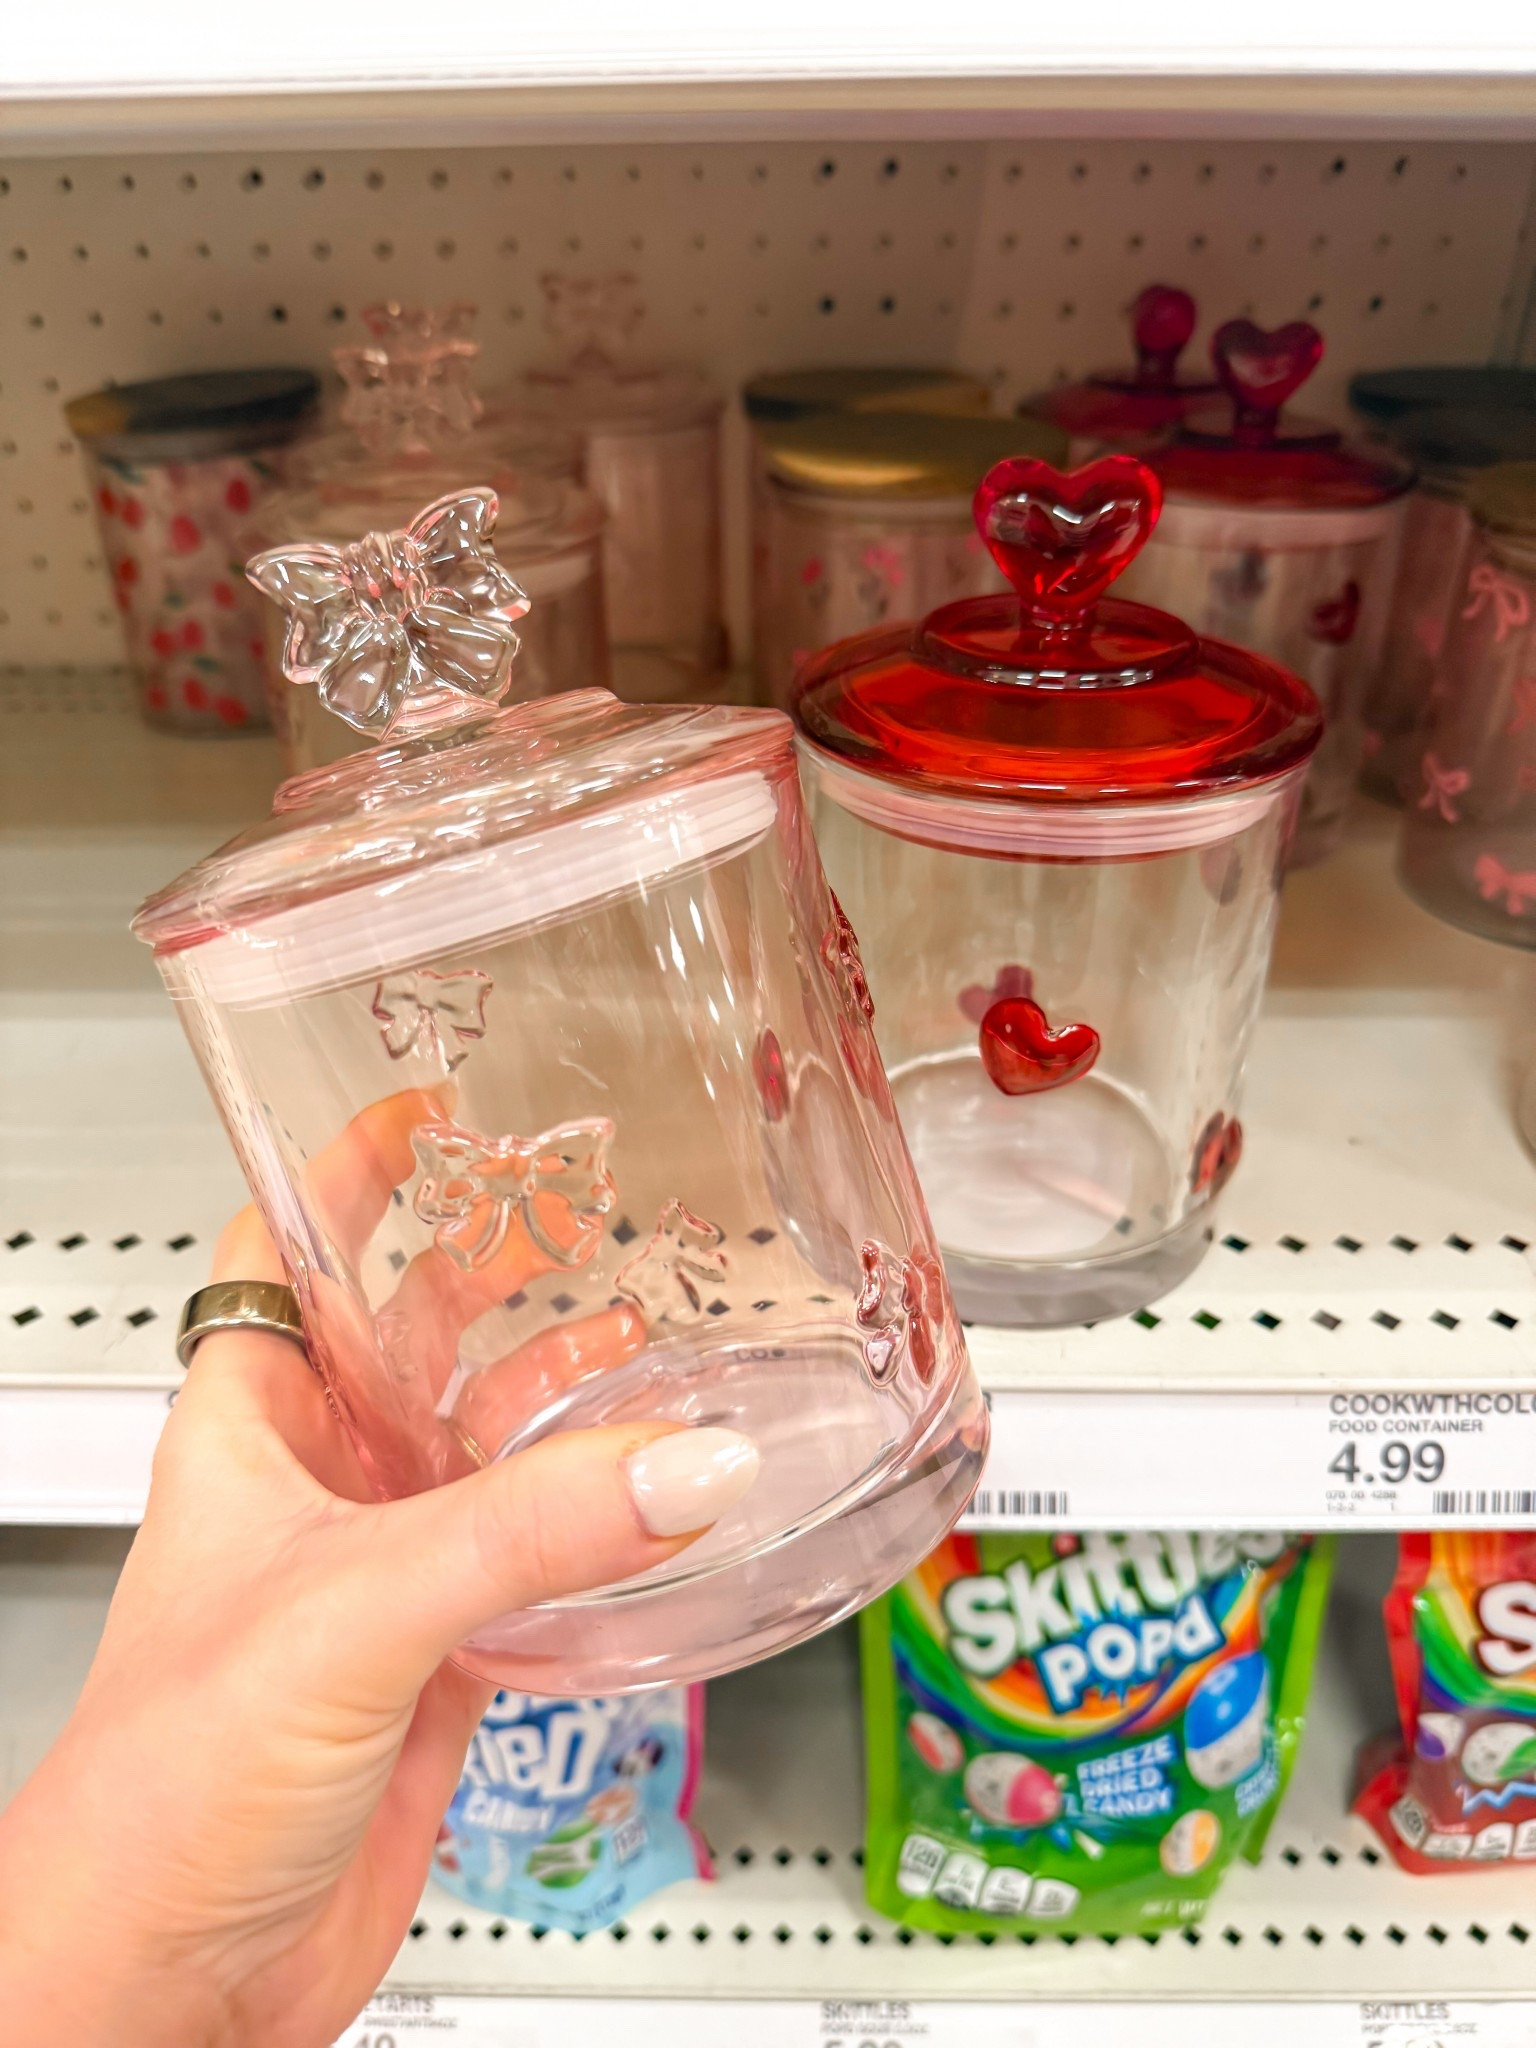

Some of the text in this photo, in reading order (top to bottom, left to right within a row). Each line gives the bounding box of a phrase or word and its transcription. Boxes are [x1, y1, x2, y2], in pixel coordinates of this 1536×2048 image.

[1329, 1392, 1536, 1415] COOKWTHCOL
[1329, 1419, 1483, 1432] FOOD CONTAINER
[1328, 1440, 1445, 1483] 4.99
[1077, 1733, 1172, 1781] FREEZE
[1083, 1786, 1172, 1818] CANDY
